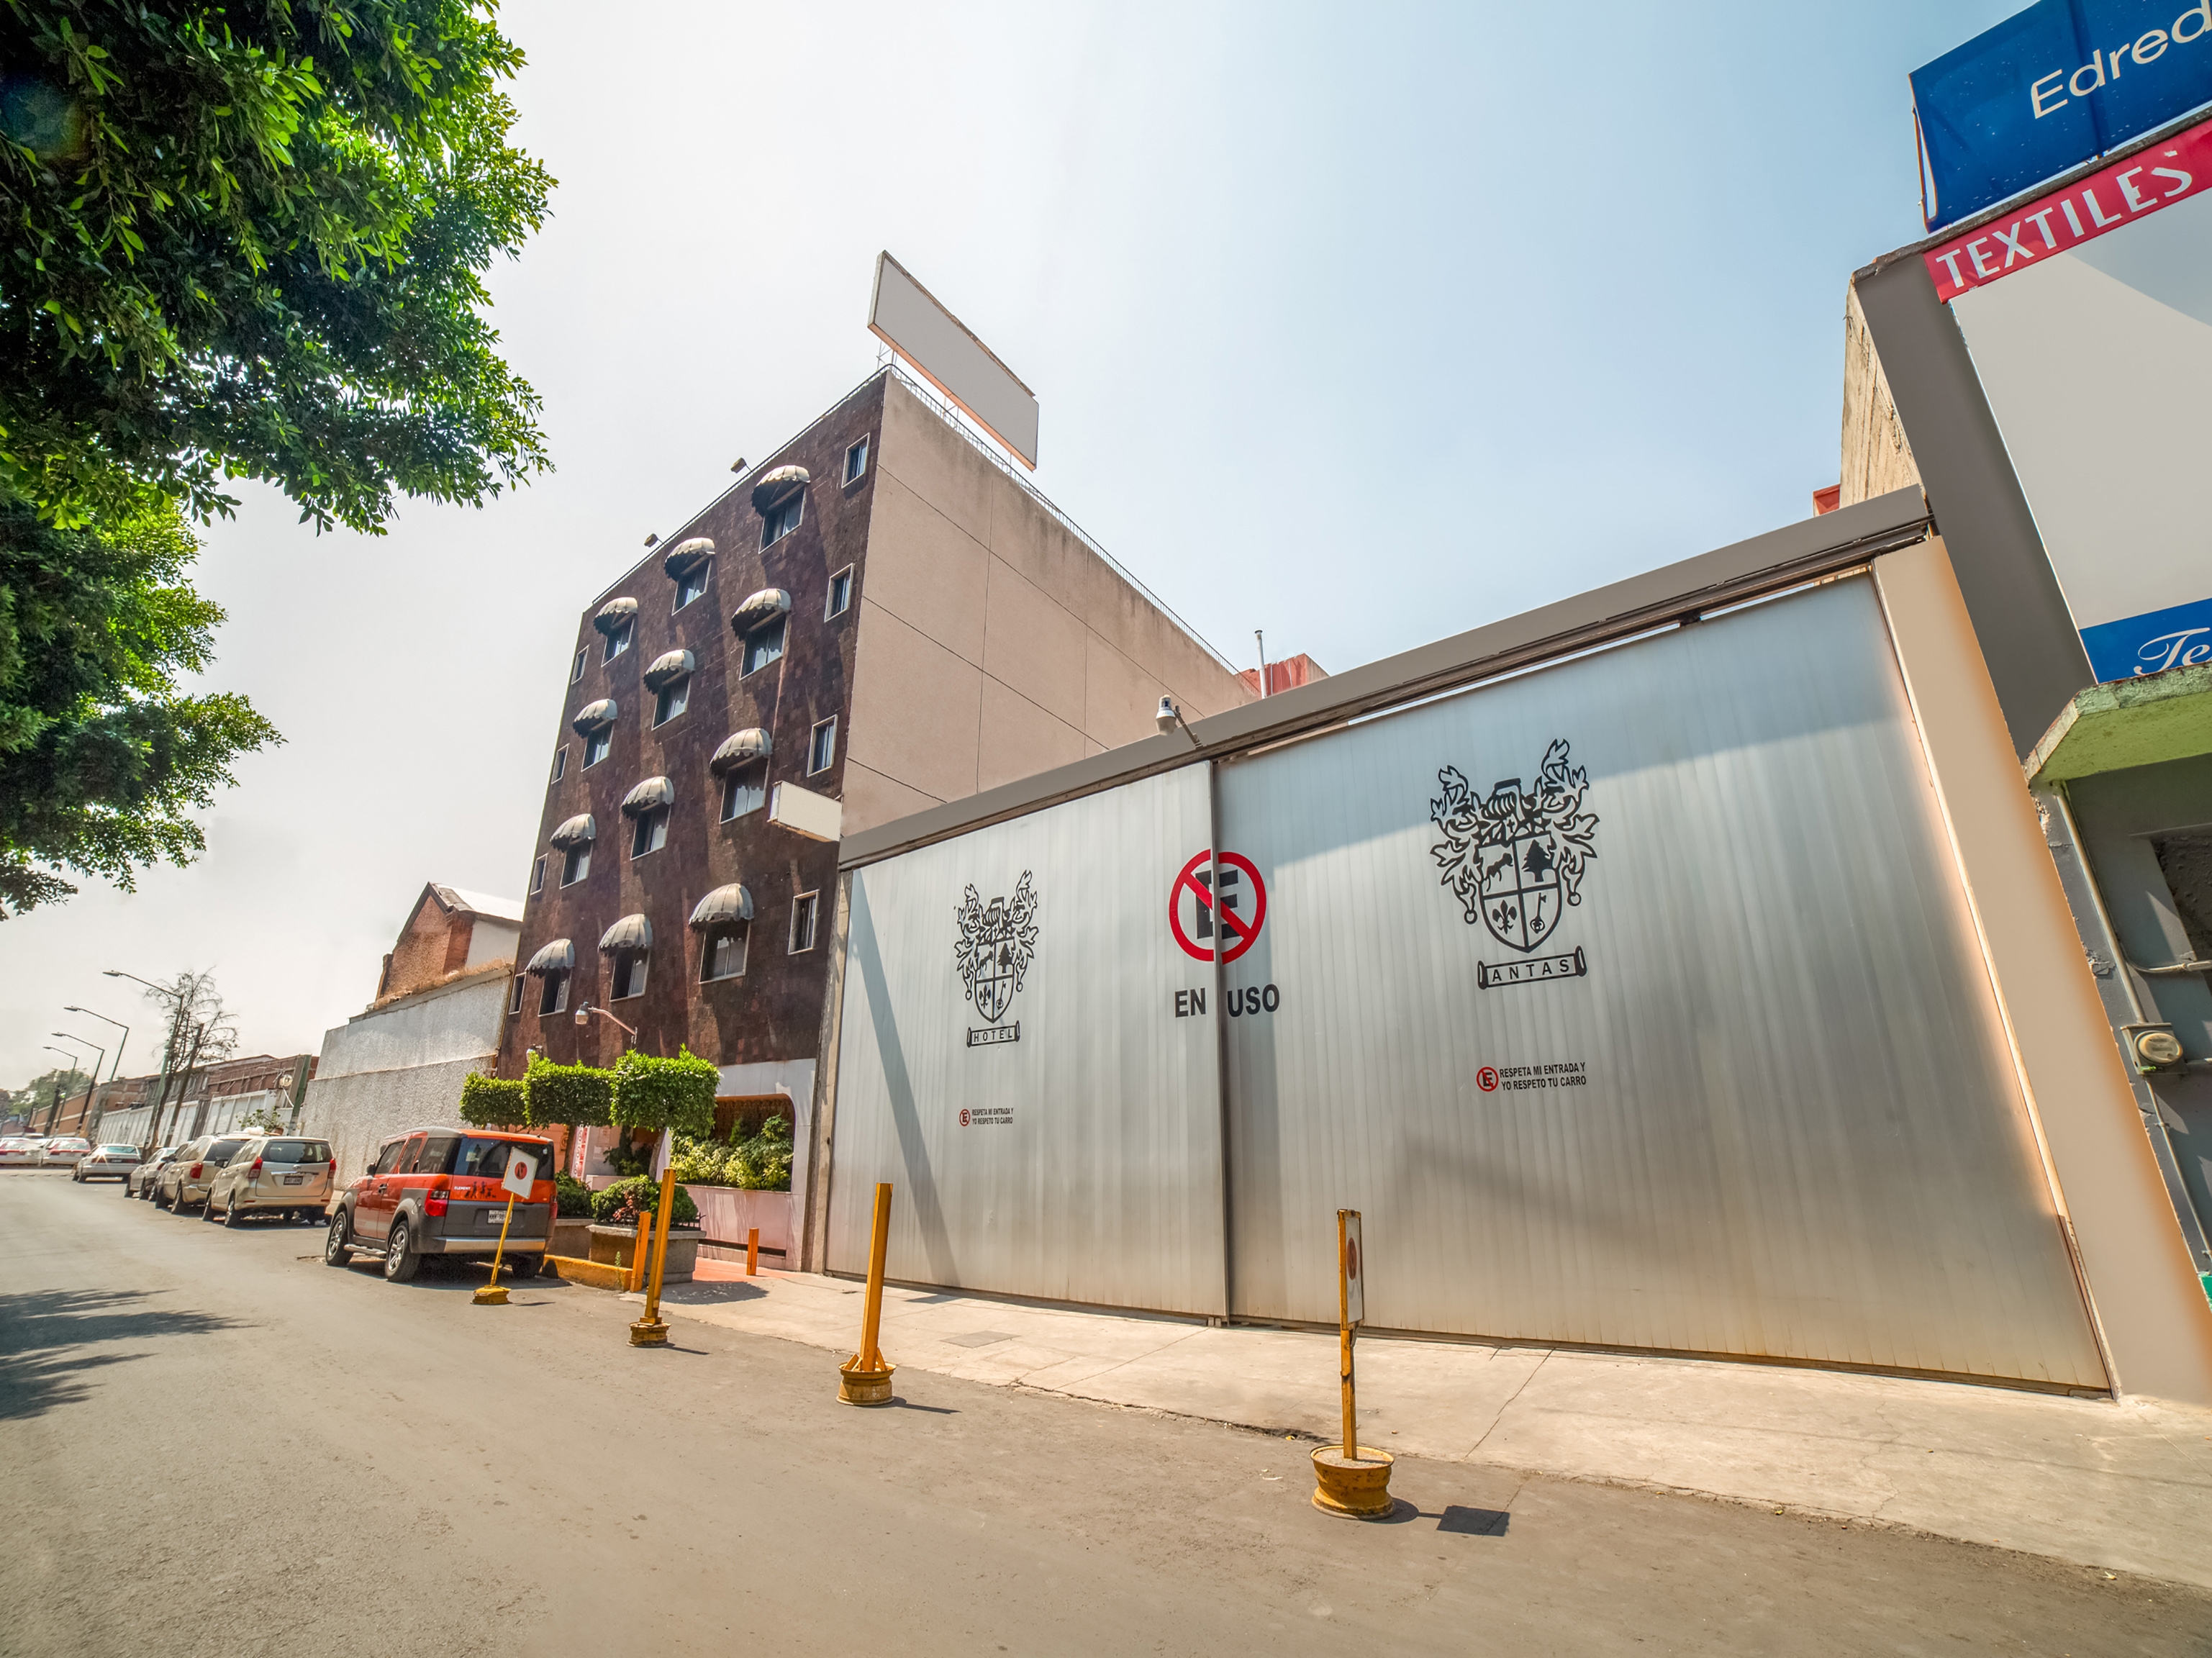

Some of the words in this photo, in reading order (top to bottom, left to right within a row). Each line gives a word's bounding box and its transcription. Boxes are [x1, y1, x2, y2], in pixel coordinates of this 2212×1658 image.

[2031, 0, 2212, 119] Edred
[1936, 150, 2192, 288] TEXTILES
[1492, 959, 1569, 982] ANTAS
[1174, 987, 1206, 1018] EN
[1227, 984, 1280, 1018] USO
[974, 1028, 1012, 1043] HOTEL
[1499, 1066, 1532, 1078] RESPETA
[1533, 1065, 1542, 1076] MI
[1544, 1063, 1579, 1074] ENTRADA
[1579, 1061, 1585, 1072] Y
[1501, 1081, 1511, 1090] YO
[1513, 1078, 1546, 1090] RESPETO
[1548, 1077, 1558, 1087] TU
[1560, 1075, 1587, 1087] CARRO
